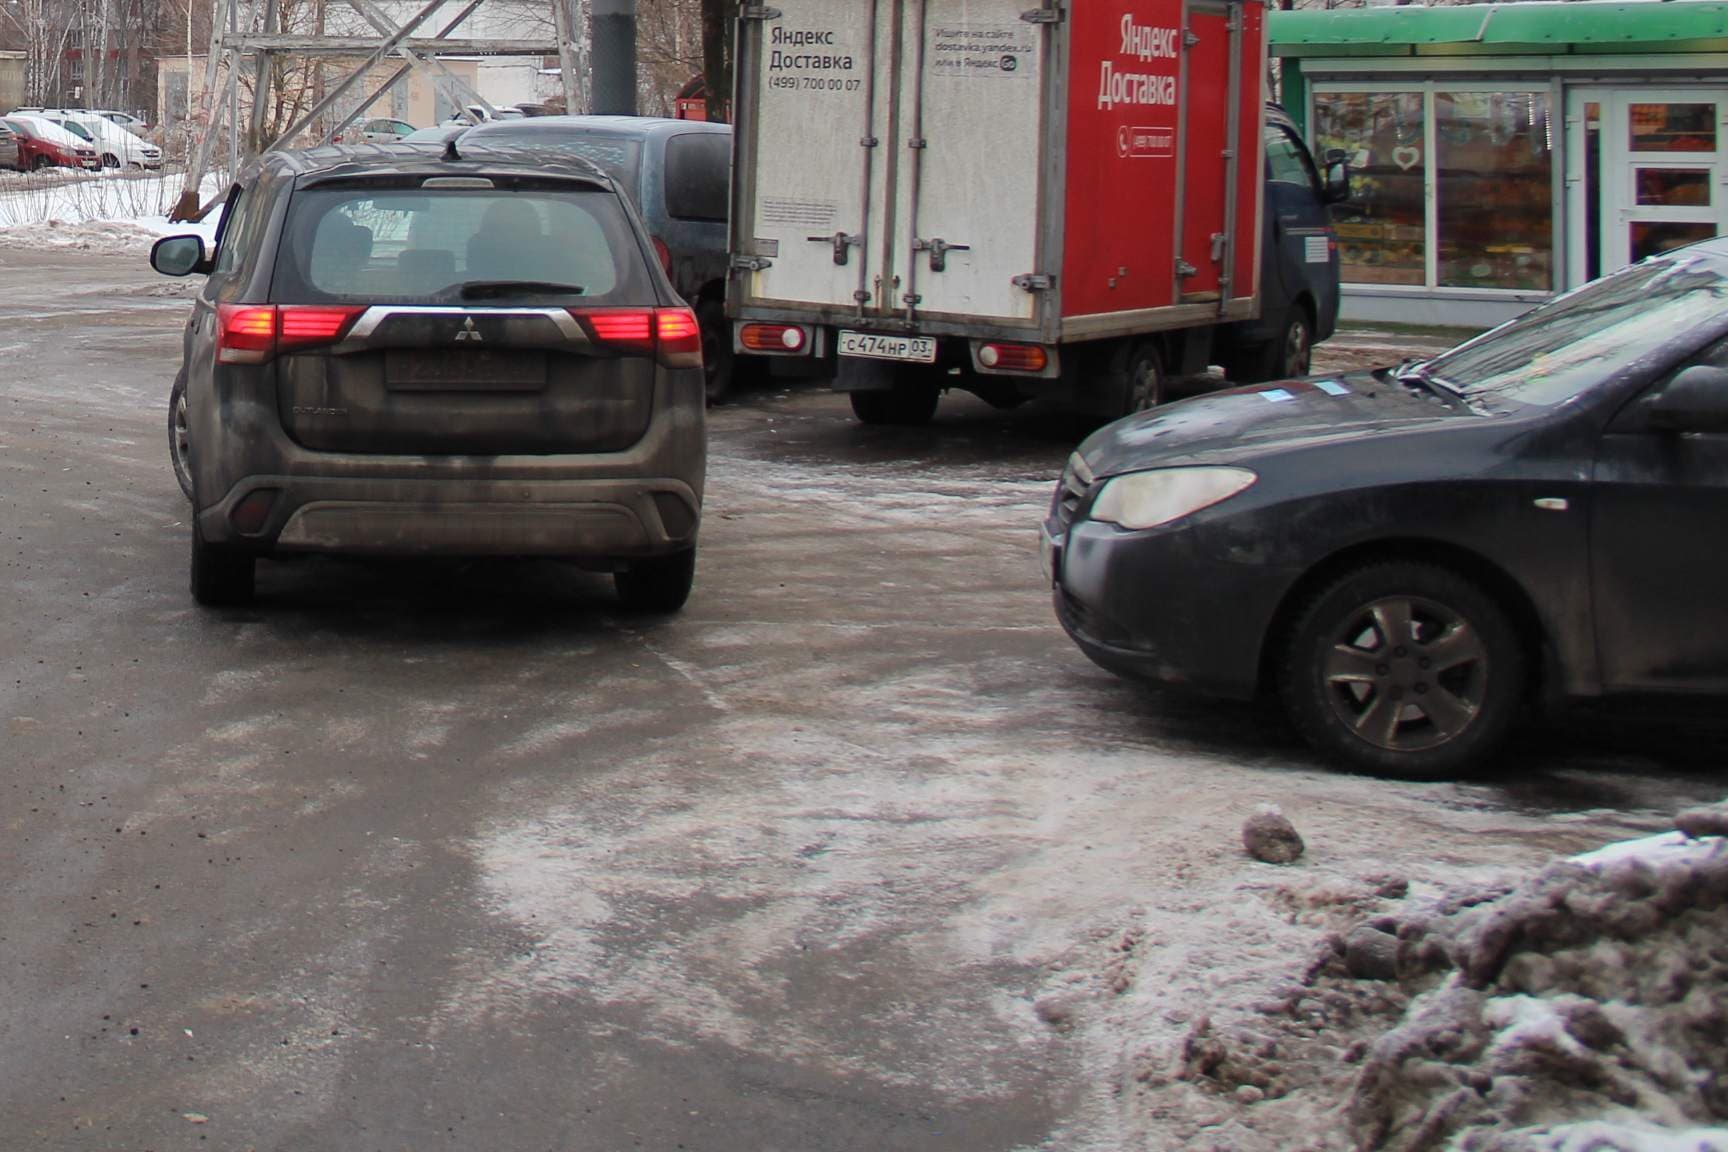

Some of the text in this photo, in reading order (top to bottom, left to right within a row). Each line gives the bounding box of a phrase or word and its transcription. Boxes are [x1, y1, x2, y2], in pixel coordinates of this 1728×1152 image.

[771, 26, 834, 47] Яндекс
[1120, 13, 1179, 63] Яндекс
[769, 50, 853, 72] Доставка
[768, 76, 862, 91] (499) 700 00 07
[1097, 60, 1176, 111] Доставка
[911, 339, 928, 353] 03
